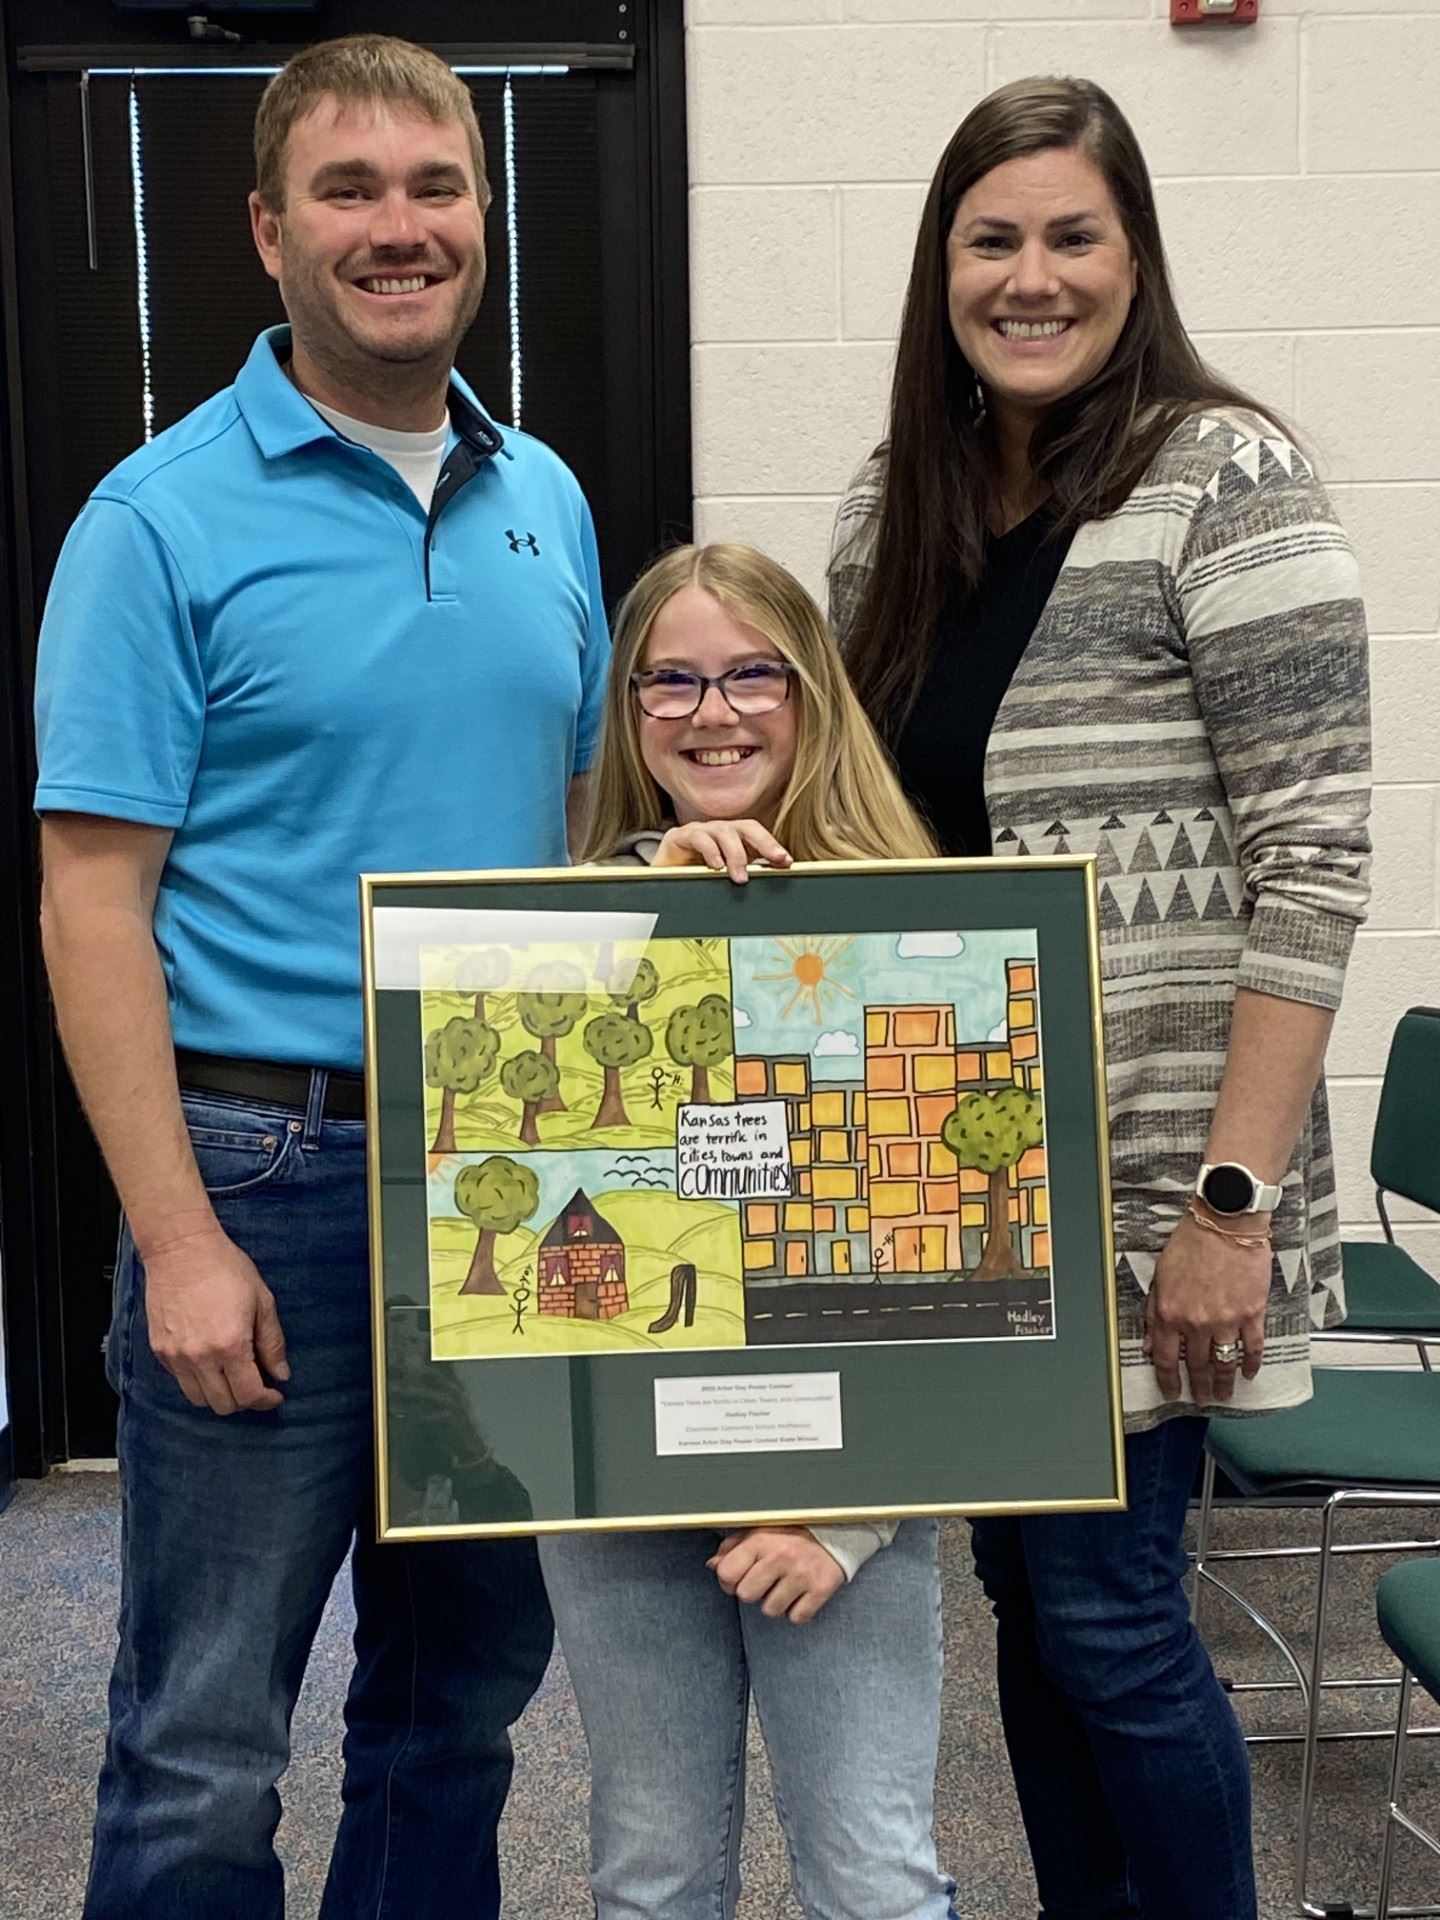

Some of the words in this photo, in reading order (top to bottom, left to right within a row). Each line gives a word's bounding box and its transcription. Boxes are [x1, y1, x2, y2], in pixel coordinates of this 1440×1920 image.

[680, 1109, 730, 1128] Kansas
[734, 1111, 768, 1127] trees
[679, 1134, 699, 1146] are
[753, 1130, 768, 1142] in
[721, 1149, 753, 1163] towns
[760, 1146, 784, 1160] and
[1007, 1309, 1046, 1326] Hadley
